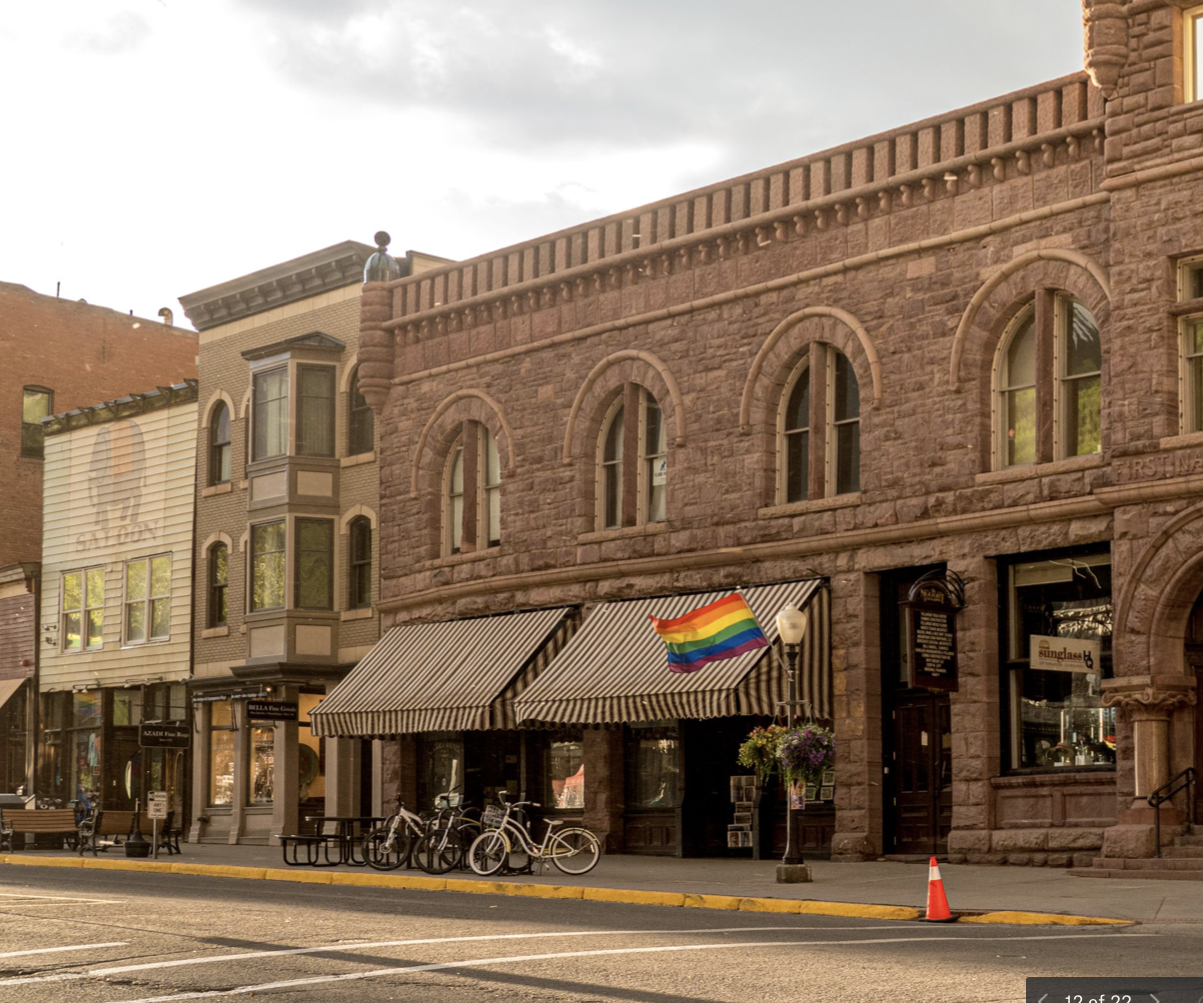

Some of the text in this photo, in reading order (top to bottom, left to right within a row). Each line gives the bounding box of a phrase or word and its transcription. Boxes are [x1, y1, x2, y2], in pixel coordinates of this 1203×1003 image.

[1115, 454, 1170, 482] FIRST
[75, 521, 159, 552] SALOON
[1038, 647, 1094, 670] sunglass HQ
